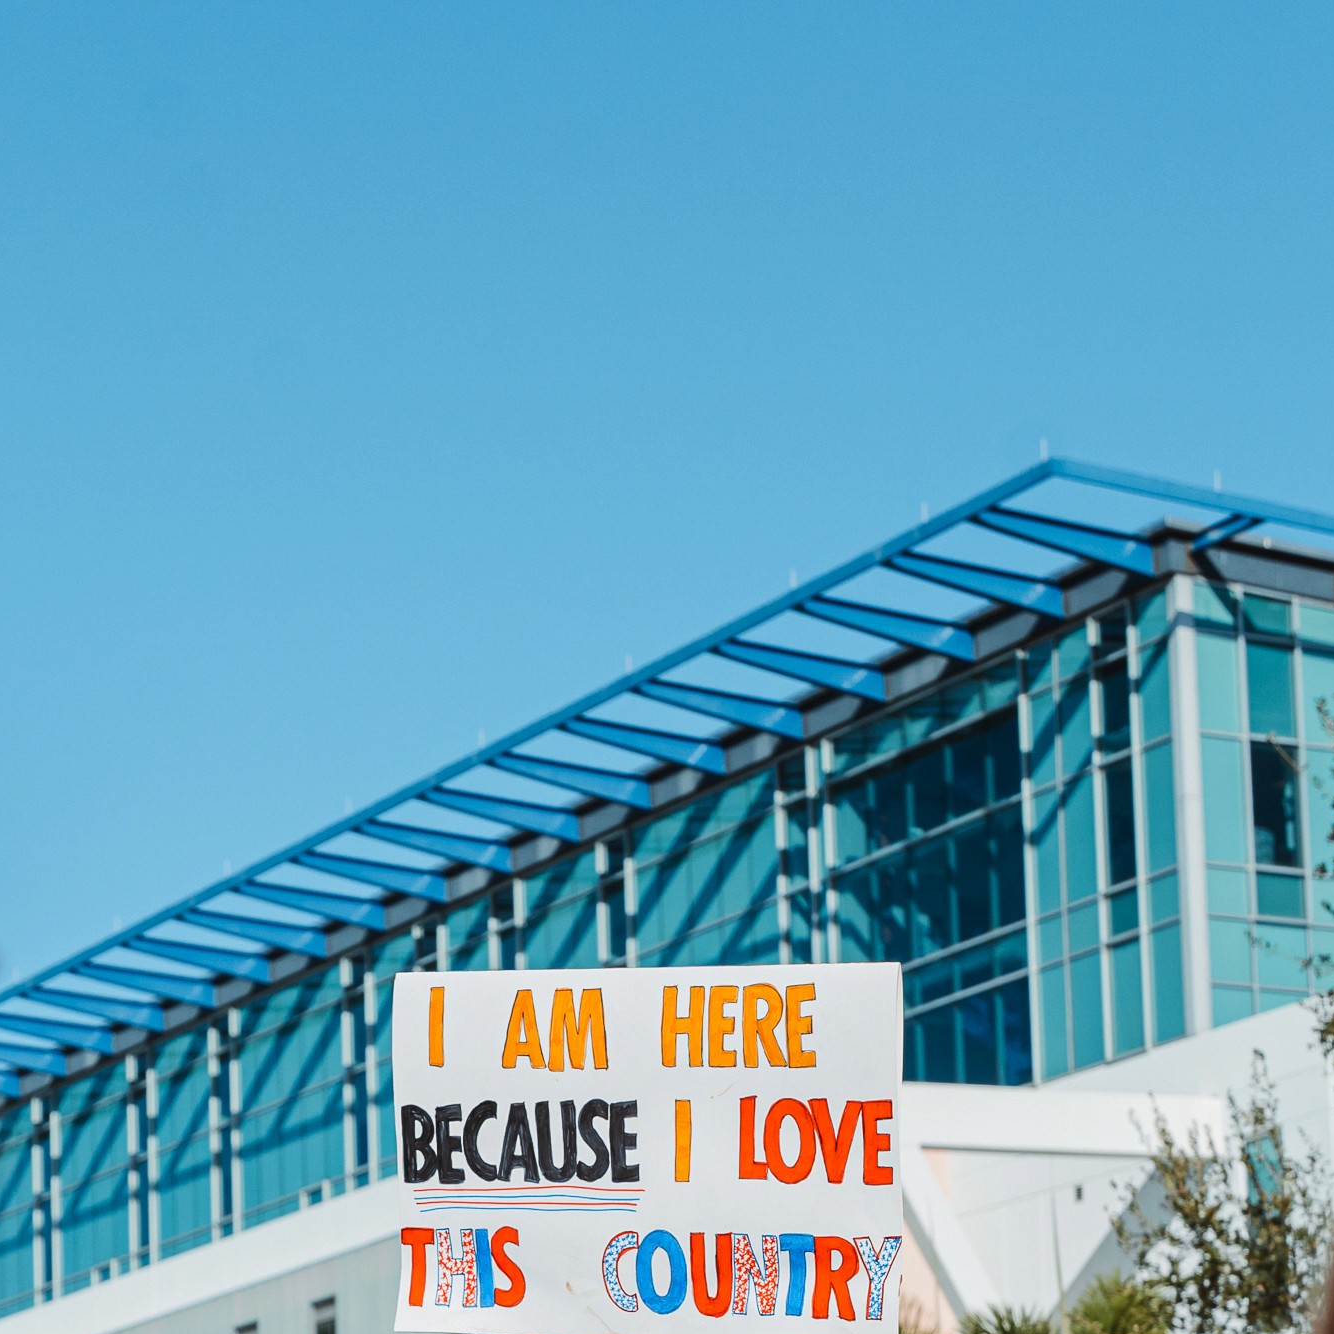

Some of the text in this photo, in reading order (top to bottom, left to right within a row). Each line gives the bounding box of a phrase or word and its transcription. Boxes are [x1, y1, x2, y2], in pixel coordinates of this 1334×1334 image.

[428, 982, 817, 1071] I AM HERE
[401, 1095, 895, 1185] BECAUSE I LOVE
[401, 1226, 902, 1321] THIS COUNTRY
